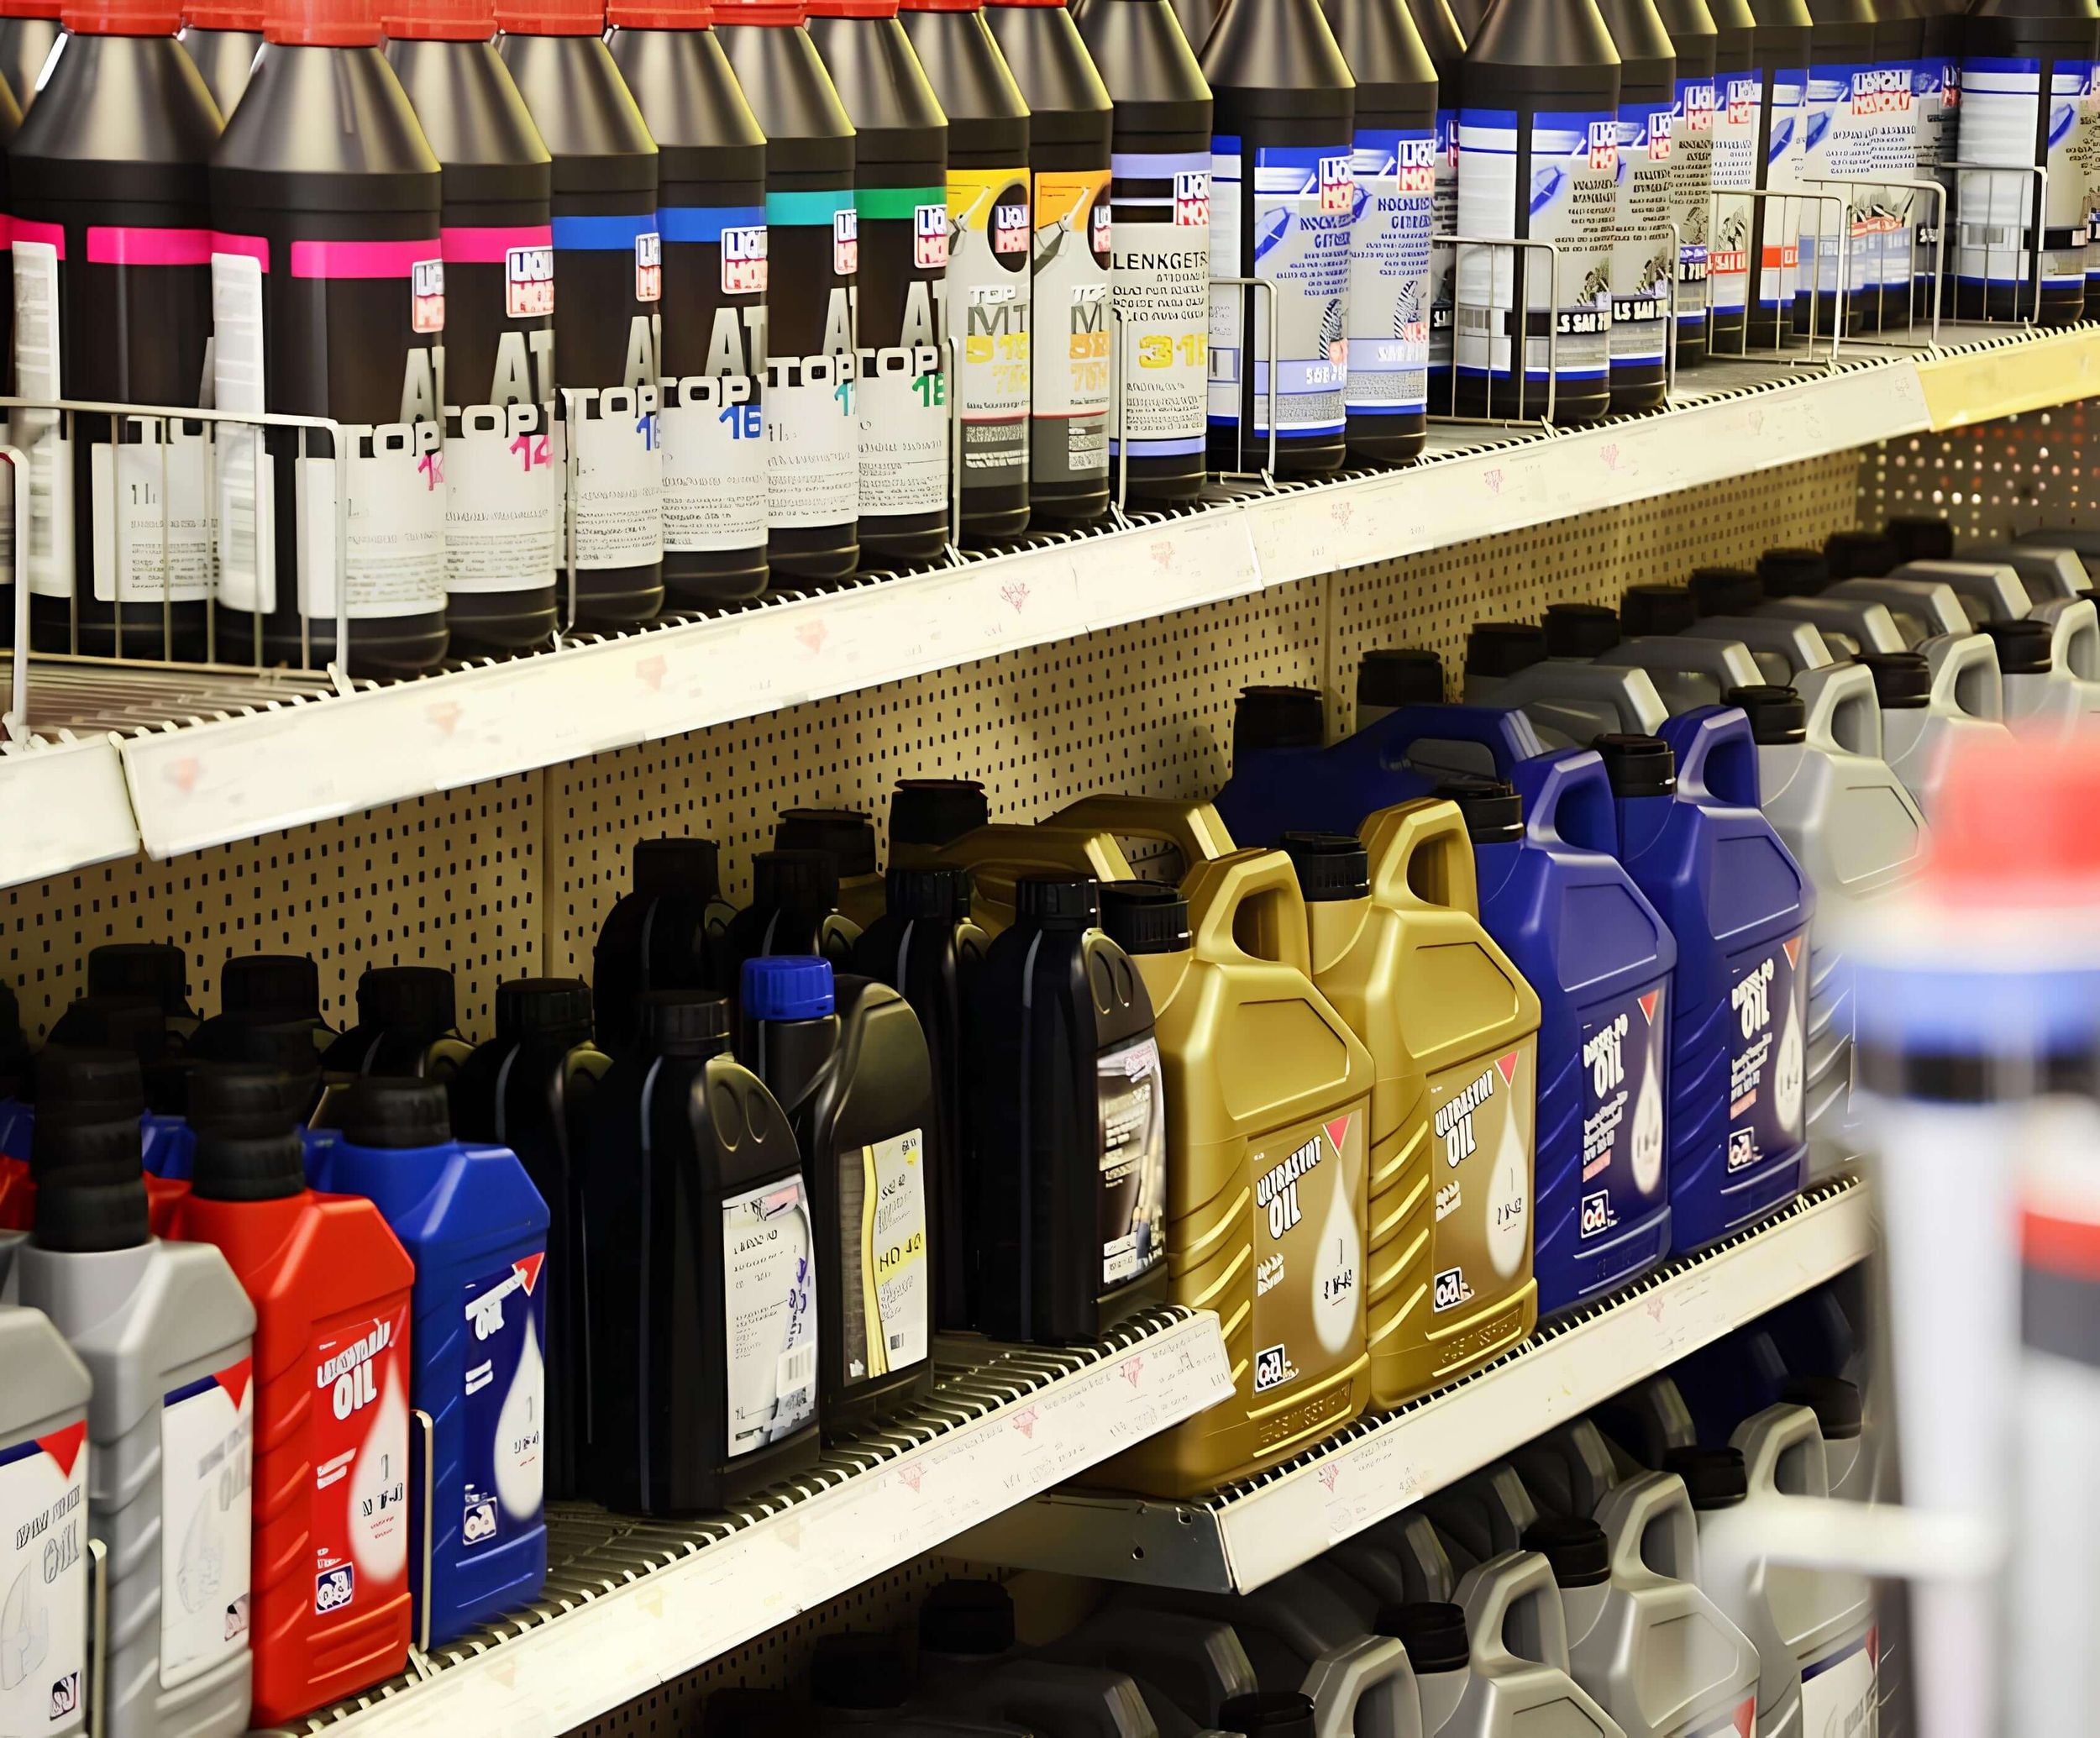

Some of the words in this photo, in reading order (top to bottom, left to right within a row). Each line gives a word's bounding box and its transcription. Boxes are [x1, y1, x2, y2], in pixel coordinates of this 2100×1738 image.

[855, 347, 938, 378] TOP
[659, 375, 751, 407] TOP
[1446, 1111, 1478, 1168] OIL
[1268, 1184, 1303, 1240] OIL
[333, 1358, 377, 1420] OIL
